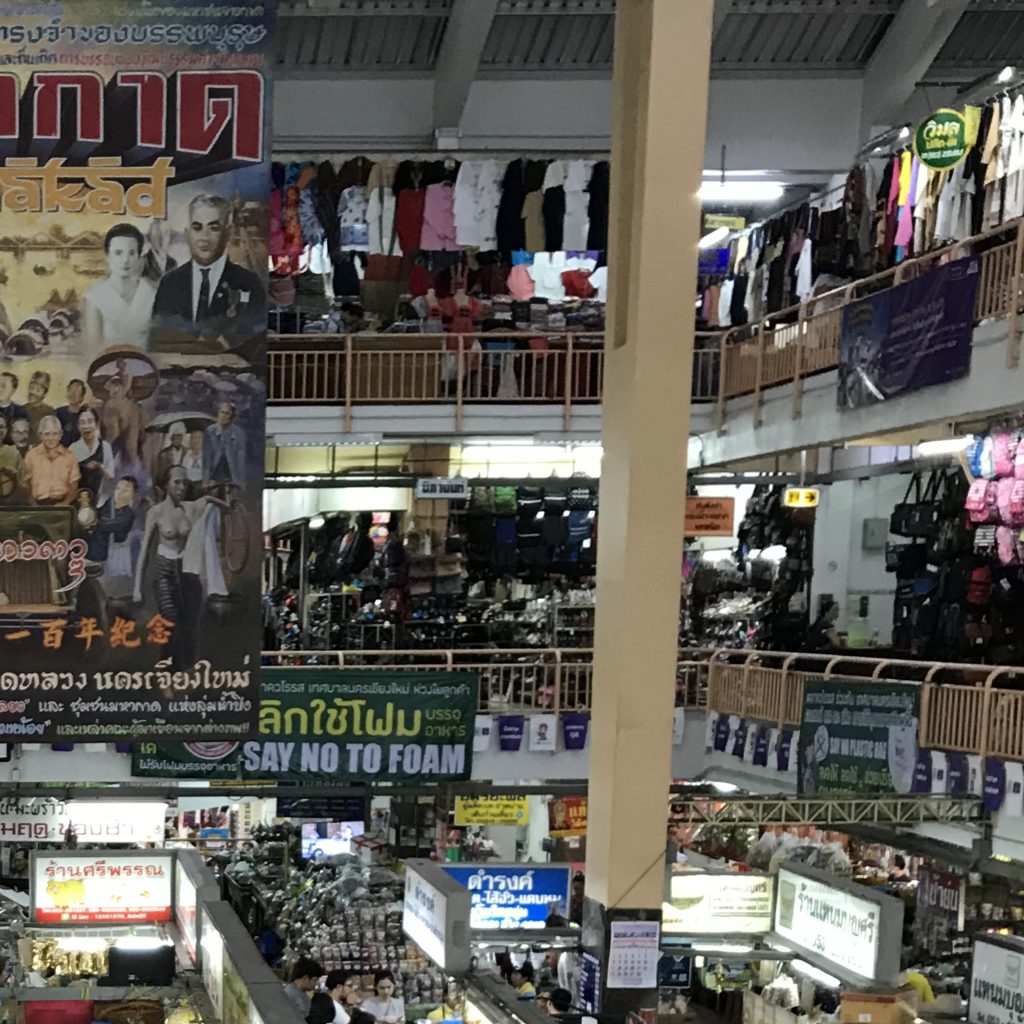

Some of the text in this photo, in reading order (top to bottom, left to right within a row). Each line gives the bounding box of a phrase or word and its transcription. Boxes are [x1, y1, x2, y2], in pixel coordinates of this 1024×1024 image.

[38, 700, 65, 713] และ
[241, 741, 467, 775] SAY NO TO FOAM
[45, 860, 165, 878] ร้านศรีพรรณ
